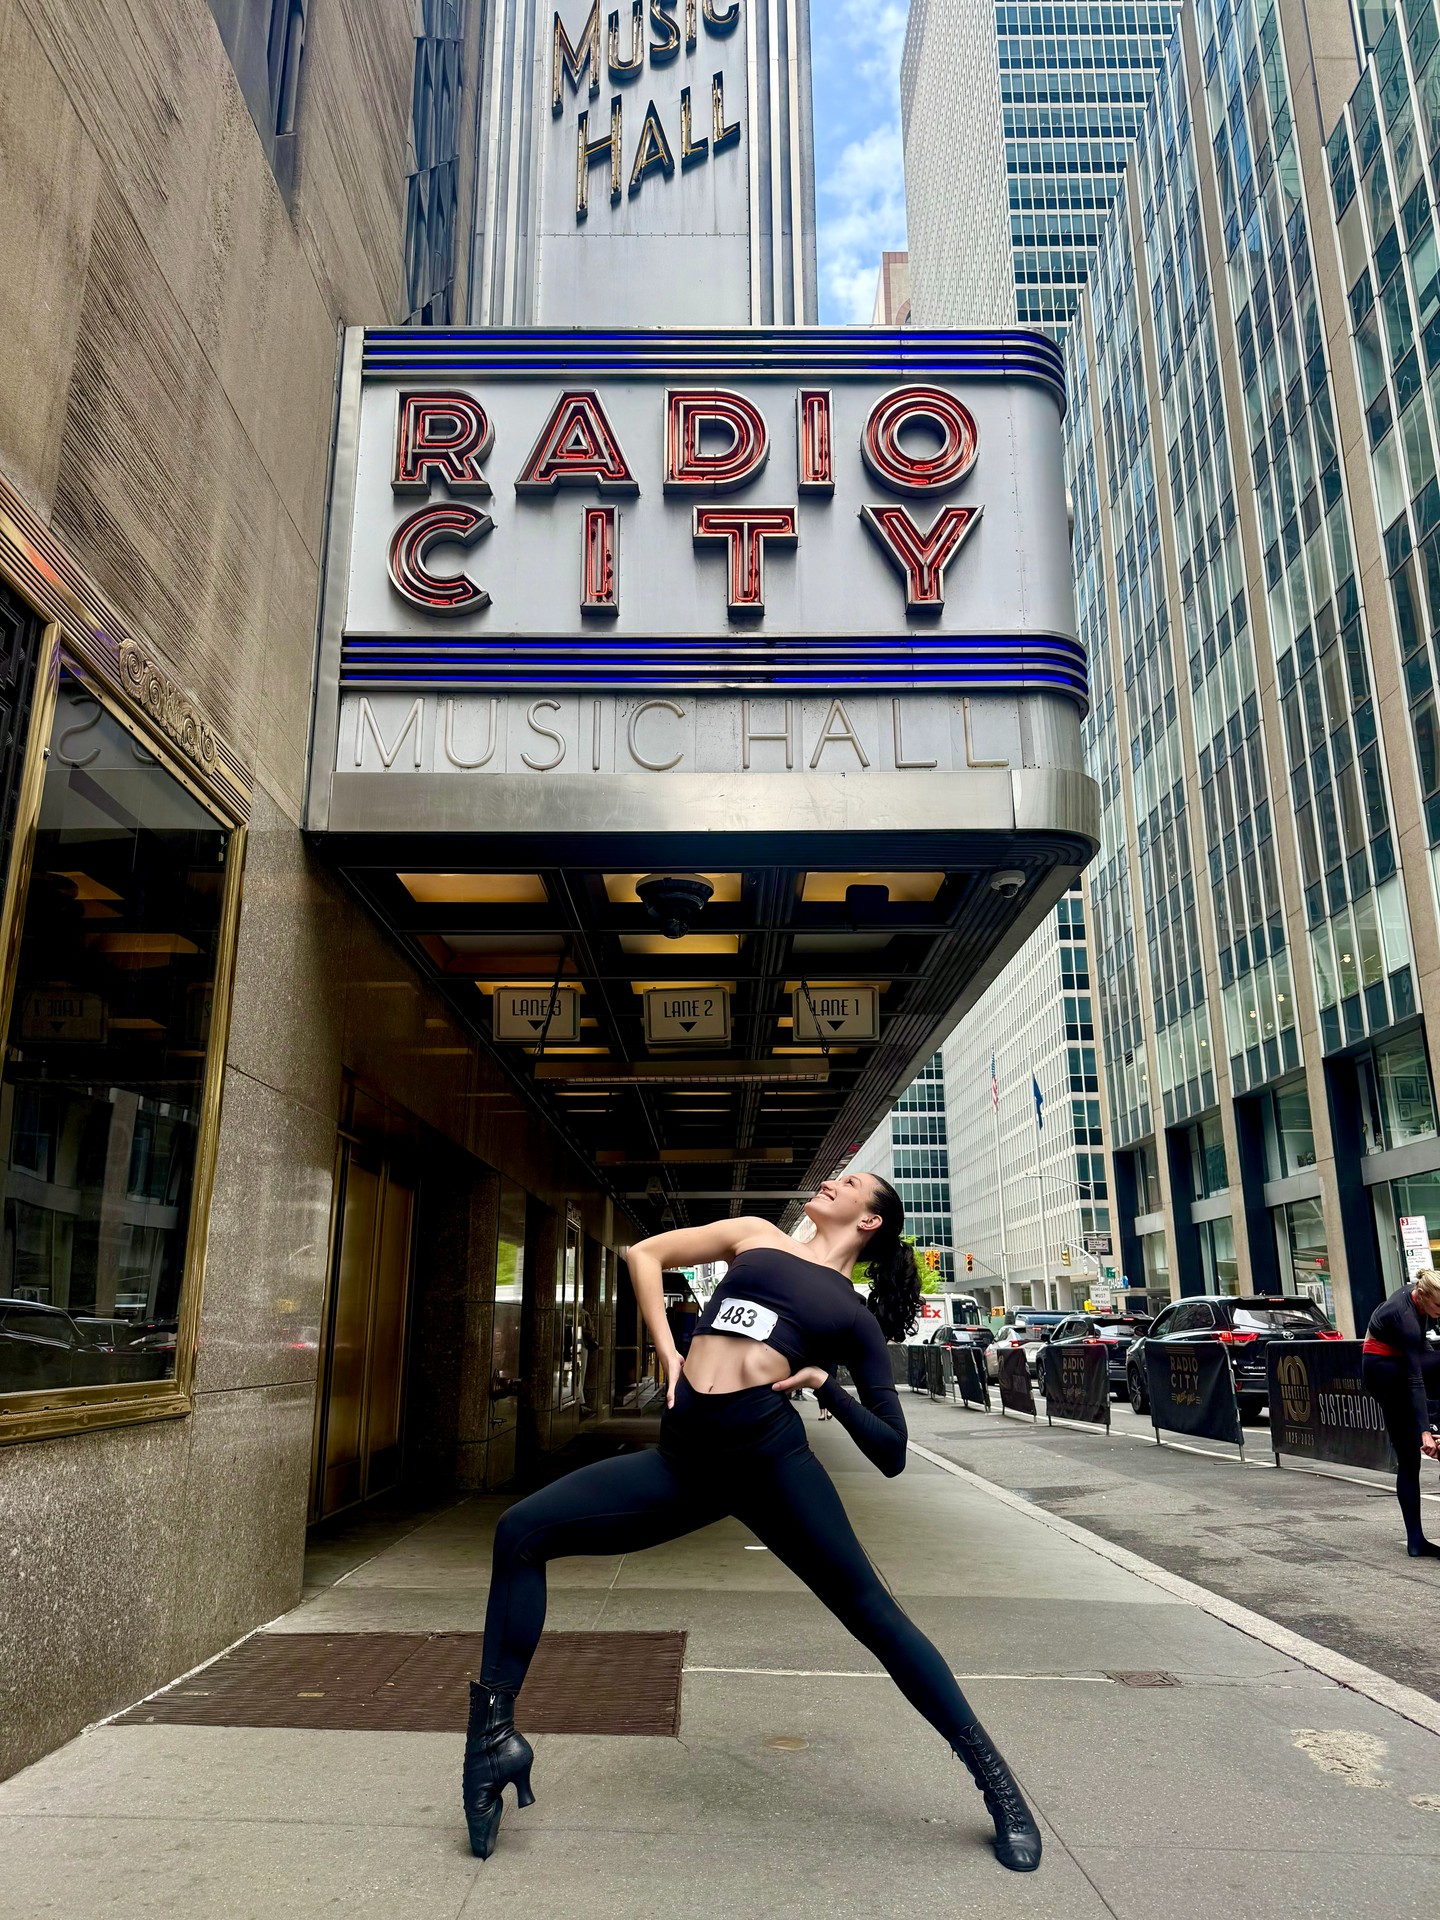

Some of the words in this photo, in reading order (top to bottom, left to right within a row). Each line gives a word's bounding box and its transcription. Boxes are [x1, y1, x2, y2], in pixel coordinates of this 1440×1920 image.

[576, 71, 740, 222] HALL
[391, 384, 979, 496] RADIO
[387, 501, 984, 617] CITY
[354, 698, 685, 771] MUSIC
[742, 698, 1009, 770] HALL
[512, 999, 549, 1016] LANE
[552, 999, 562, 1016] 3
[664, 1000, 700, 1018] LANE
[704, 999, 714, 1017] 2
[812, 999, 849, 1016] LANE
[854, 999, 860, 1016] 1
[720, 1306, 758, 1327] 483
[1063, 1357, 1085, 1371] RADIO
[1170, 1357, 1199, 1373] RADIO
[1063, 1372, 1085, 1384] CITY
[1171, 1374, 1199, 1391] CITY
[1318, 1393, 1386, 1432] SISTERHOOD
